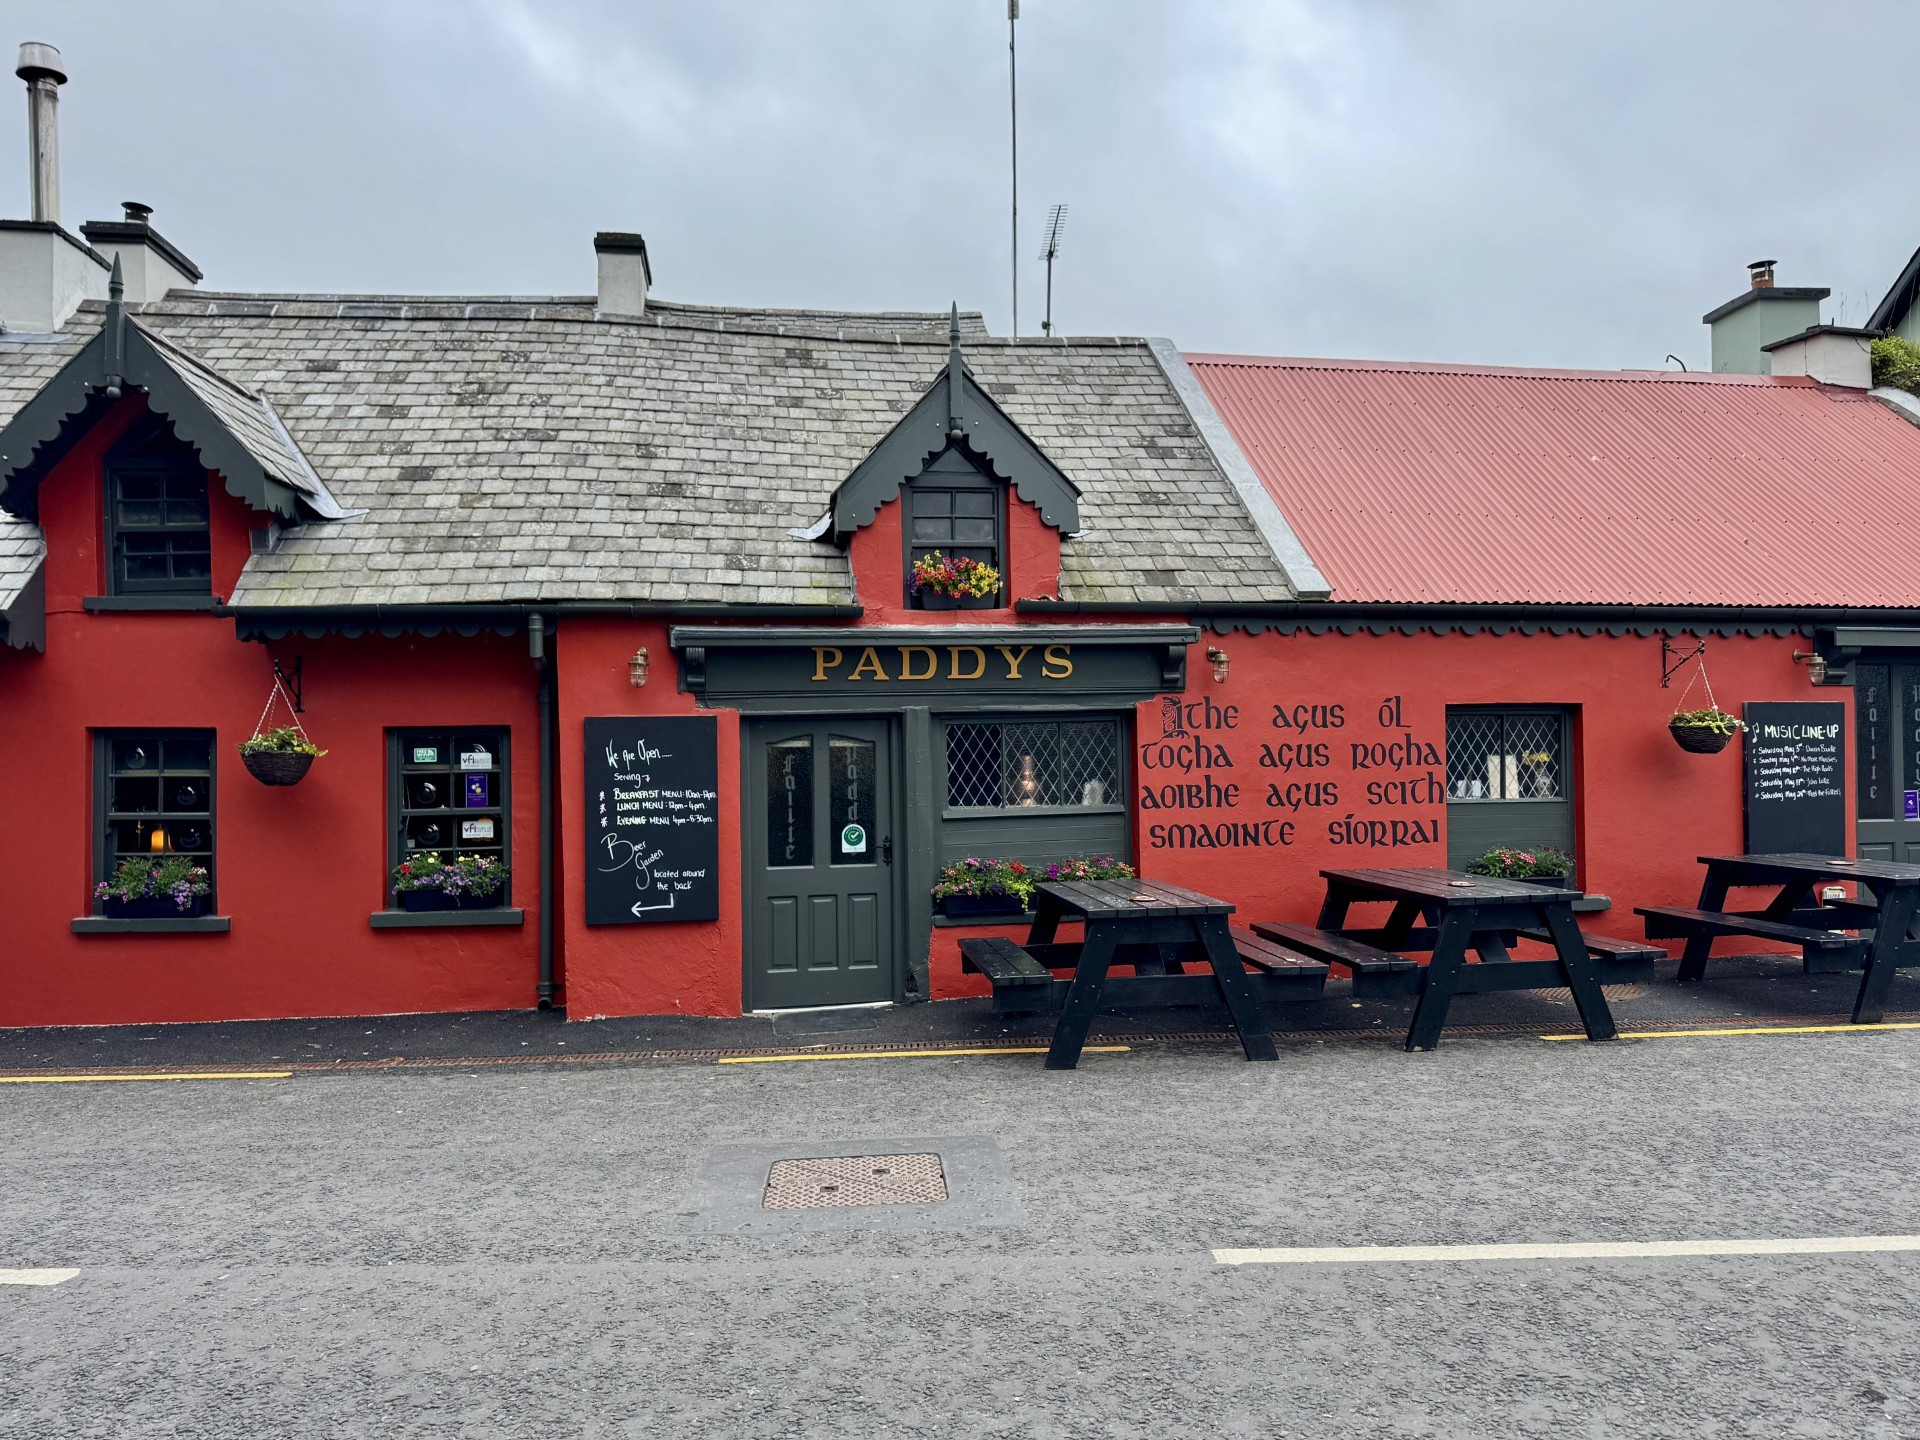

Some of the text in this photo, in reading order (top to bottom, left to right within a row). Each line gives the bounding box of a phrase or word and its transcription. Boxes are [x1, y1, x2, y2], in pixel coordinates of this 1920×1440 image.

[811, 644, 1073, 681] PADDYS
[1272, 704, 1345, 735] agus
[1764, 724, 1839, 739] MUSIC LINE-UP
[605, 738, 619, 769] We
[623, 750, 636, 771] Are
[1258, 743, 1330, 773] agus
[1759, 746, 1783, 756] Saturday
[1784, 745, 1795, 755] May
[1760, 767, 1782, 776] Saturday
[613, 772, 641, 788] Serving
[1760, 778, 1783, 788] Saturday
[1266, 782, 1339, 812] agus
[1761, 791, 1784, 802] Saturday
[616, 801, 640, 811] LUNCH
[616, 815, 647, 826] EVENING
[649, 816, 670, 826] MENU
[598, 832, 647, 872] Beer
[635, 849, 664, 890] Garden
[653, 868, 706, 878] located around
[656, 881, 692, 890] the back
